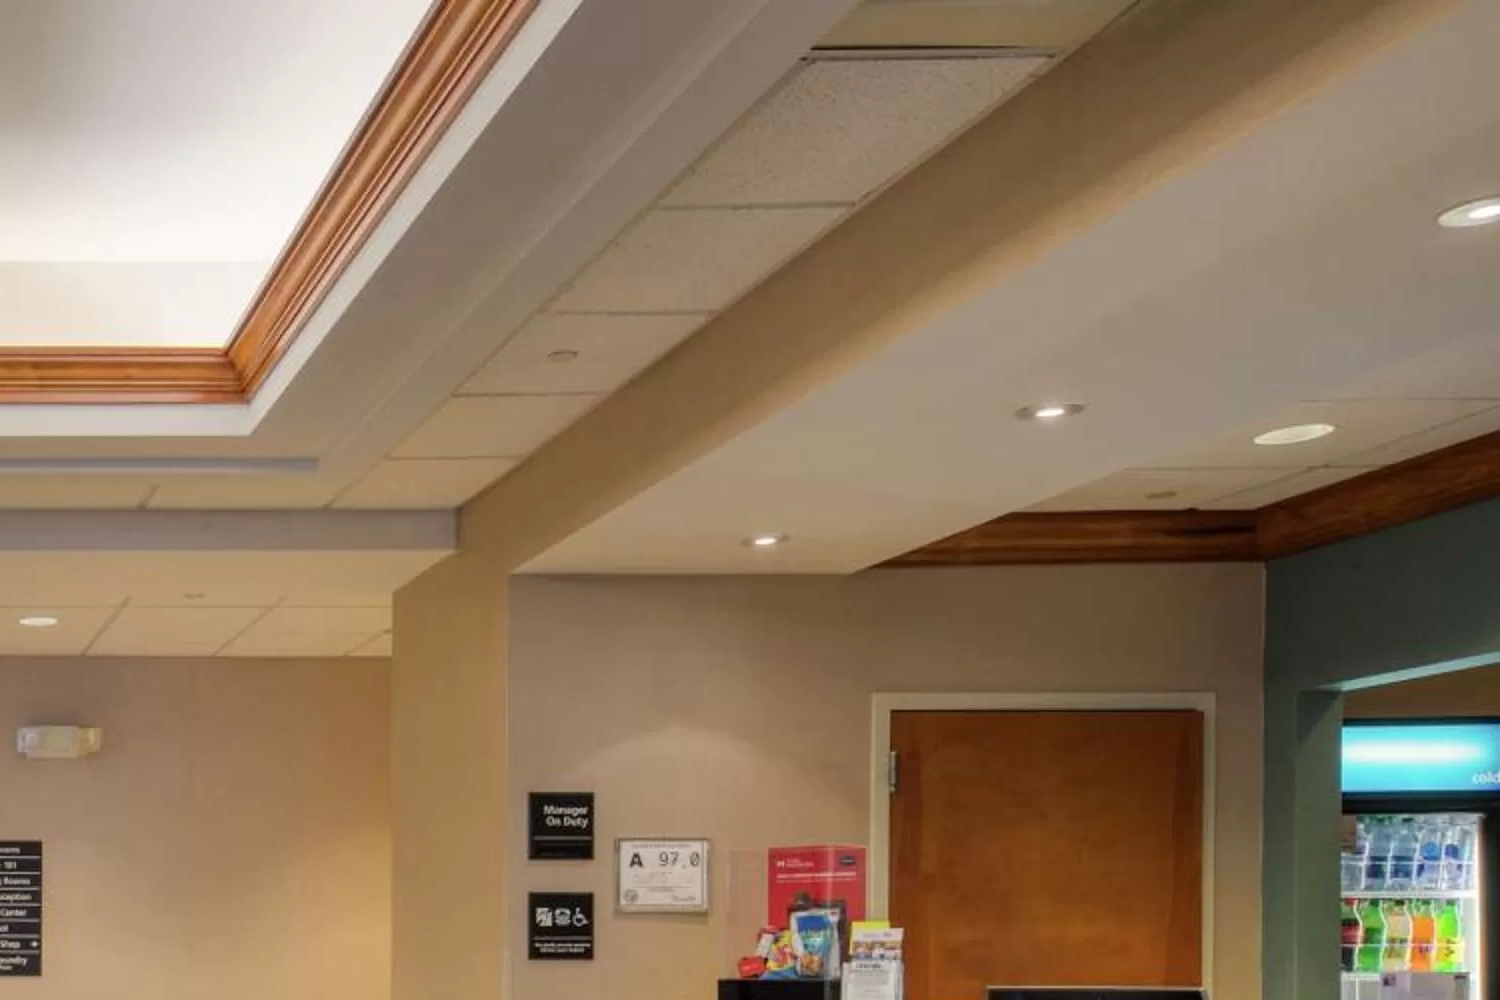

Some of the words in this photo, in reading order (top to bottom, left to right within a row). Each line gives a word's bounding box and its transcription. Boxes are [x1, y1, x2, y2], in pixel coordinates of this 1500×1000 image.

[543, 805, 588, 817] Manager
[545, 817, 561, 827] On
[563, 817, 589, 829] Duty
[629, 851, 644, 868] A
